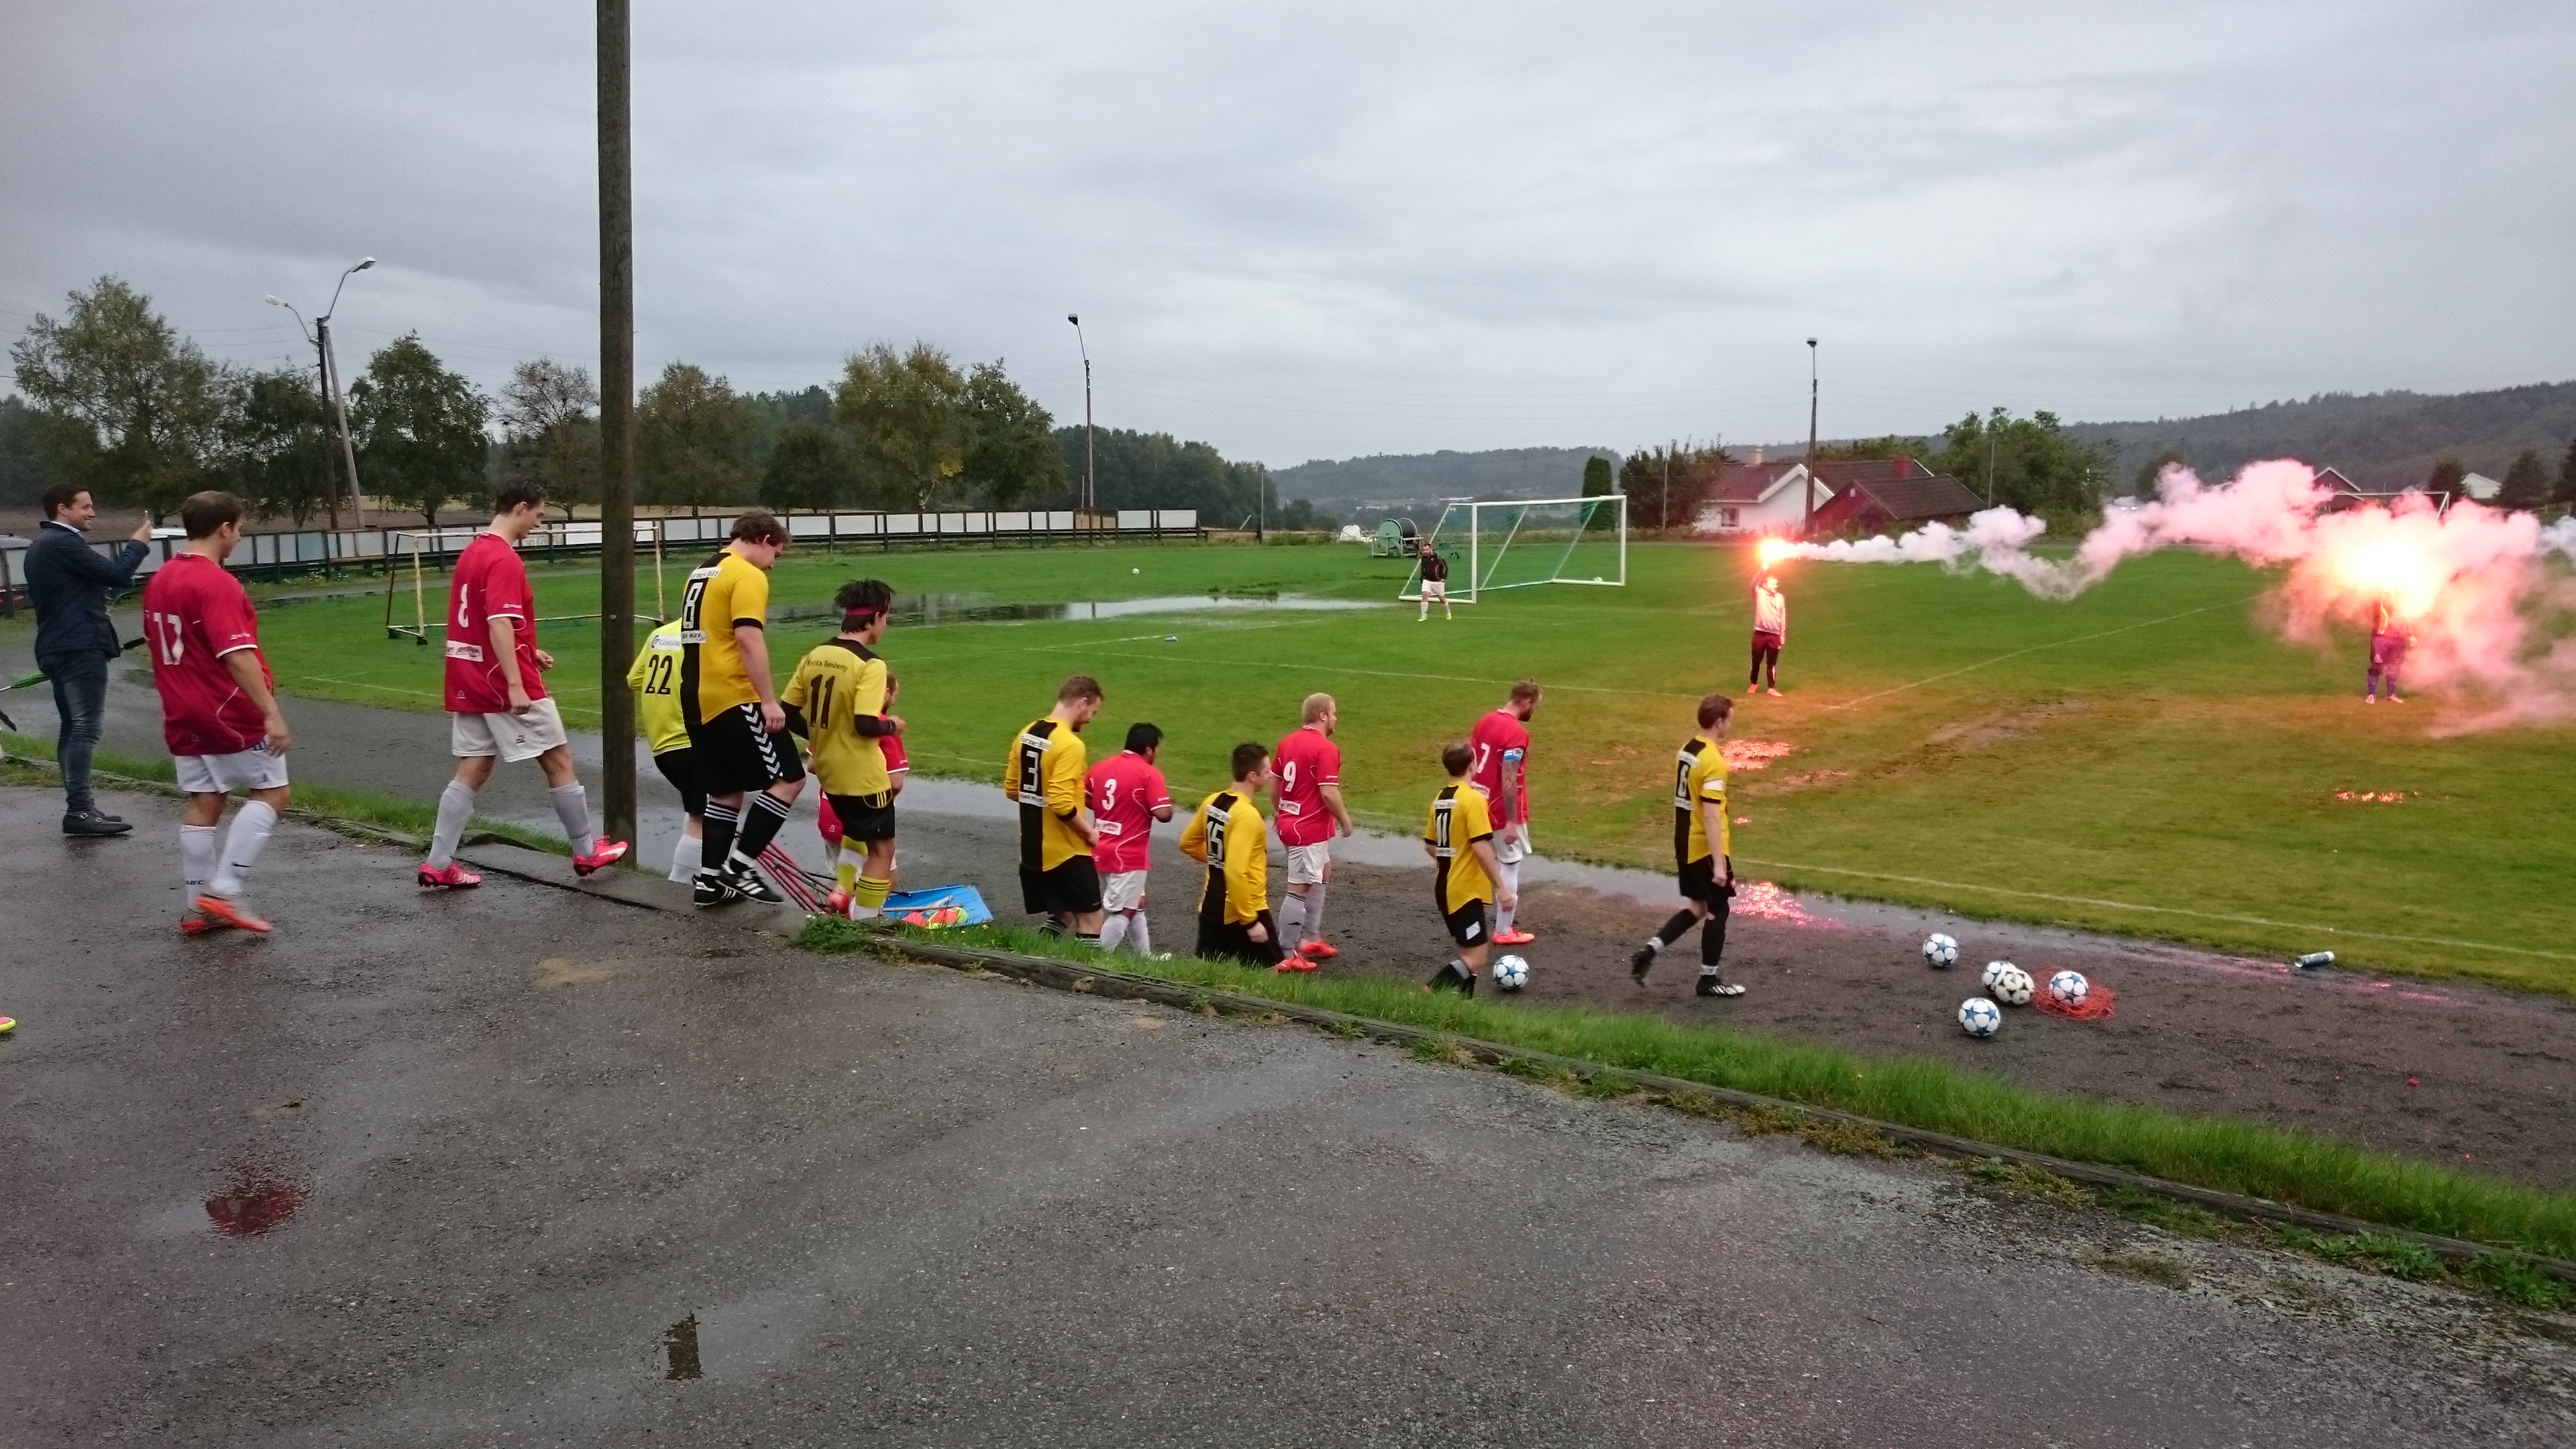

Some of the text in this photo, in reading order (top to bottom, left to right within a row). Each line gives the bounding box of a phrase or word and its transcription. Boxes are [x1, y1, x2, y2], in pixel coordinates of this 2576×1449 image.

[683, 582, 704, 629] 8
[645, 654, 673, 694] 22
[810, 674, 835, 730] 11
[1023, 750, 1040, 792] 3
[1283, 761, 1296, 792] 9
[1477, 743, 1491, 774] 7
[1102, 778, 1117, 810] 3
[1207, 820, 1225, 861] 15
[1436, 812, 1448, 846] 11
